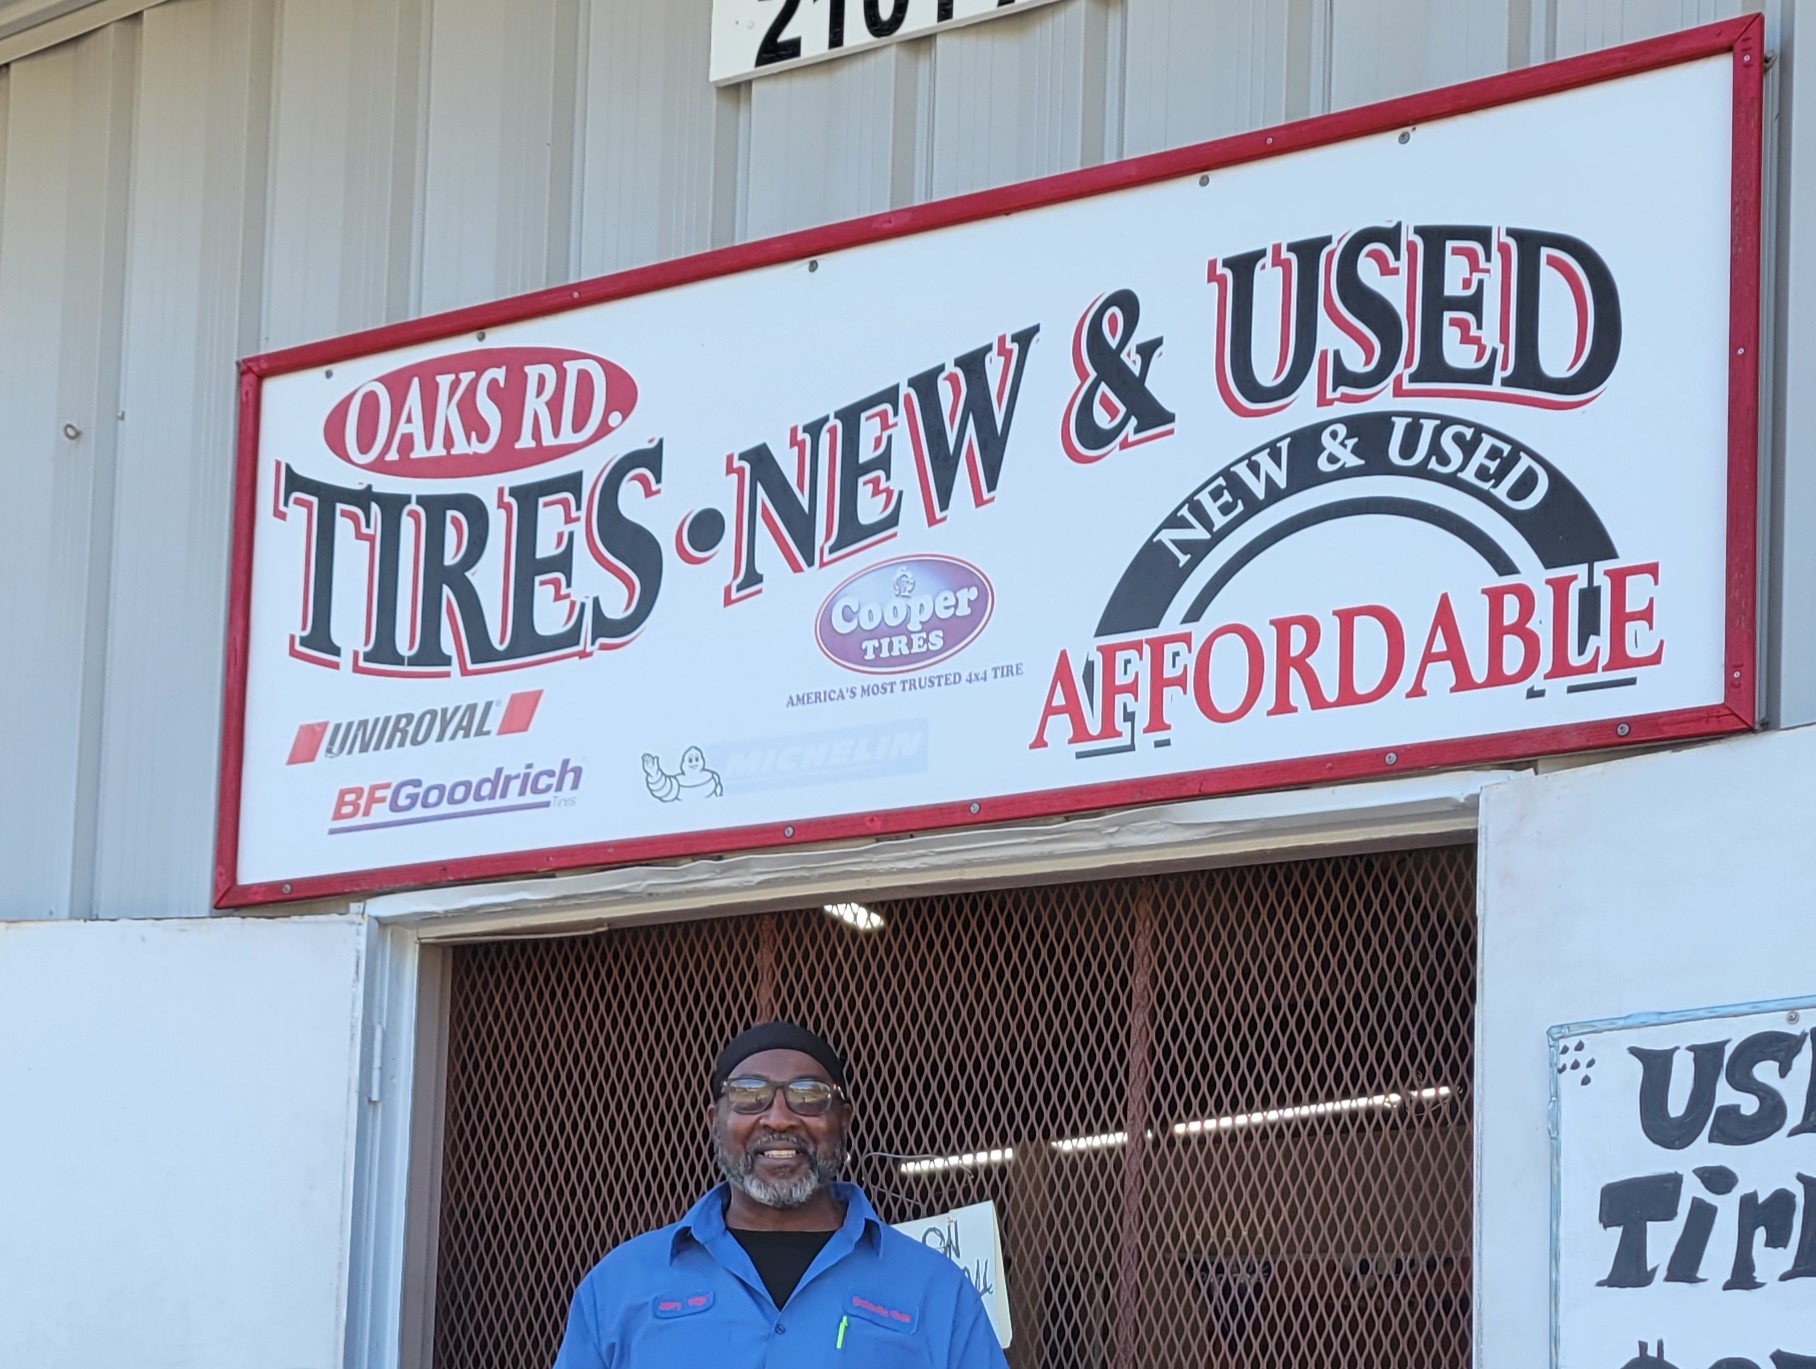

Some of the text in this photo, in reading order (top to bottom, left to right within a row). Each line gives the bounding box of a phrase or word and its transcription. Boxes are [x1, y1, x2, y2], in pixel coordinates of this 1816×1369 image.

[345, 358, 623, 465] OAKS RD.
[273, 220, 1622, 677] TIRES NEW & USED
[1154, 416, 1549, 567] NEW & USED
[831, 586, 978, 634] Cooper
[861, 629, 944, 660] TIRES
[1029, 562, 1665, 754] AFFORDABLE
[786, 686, 857, 708] AMERICA'S
[860, 681, 896, 699] MOST
[899, 671, 962, 693] TRUSTED
[991, 662, 1024, 680] TIRE
[324, 699, 494, 759] UNIROYAL
[724, 731, 923, 777] MICHELIN
[331, 757, 583, 821] BFGoodrich
[1627, 1027, 1816, 1150] US
